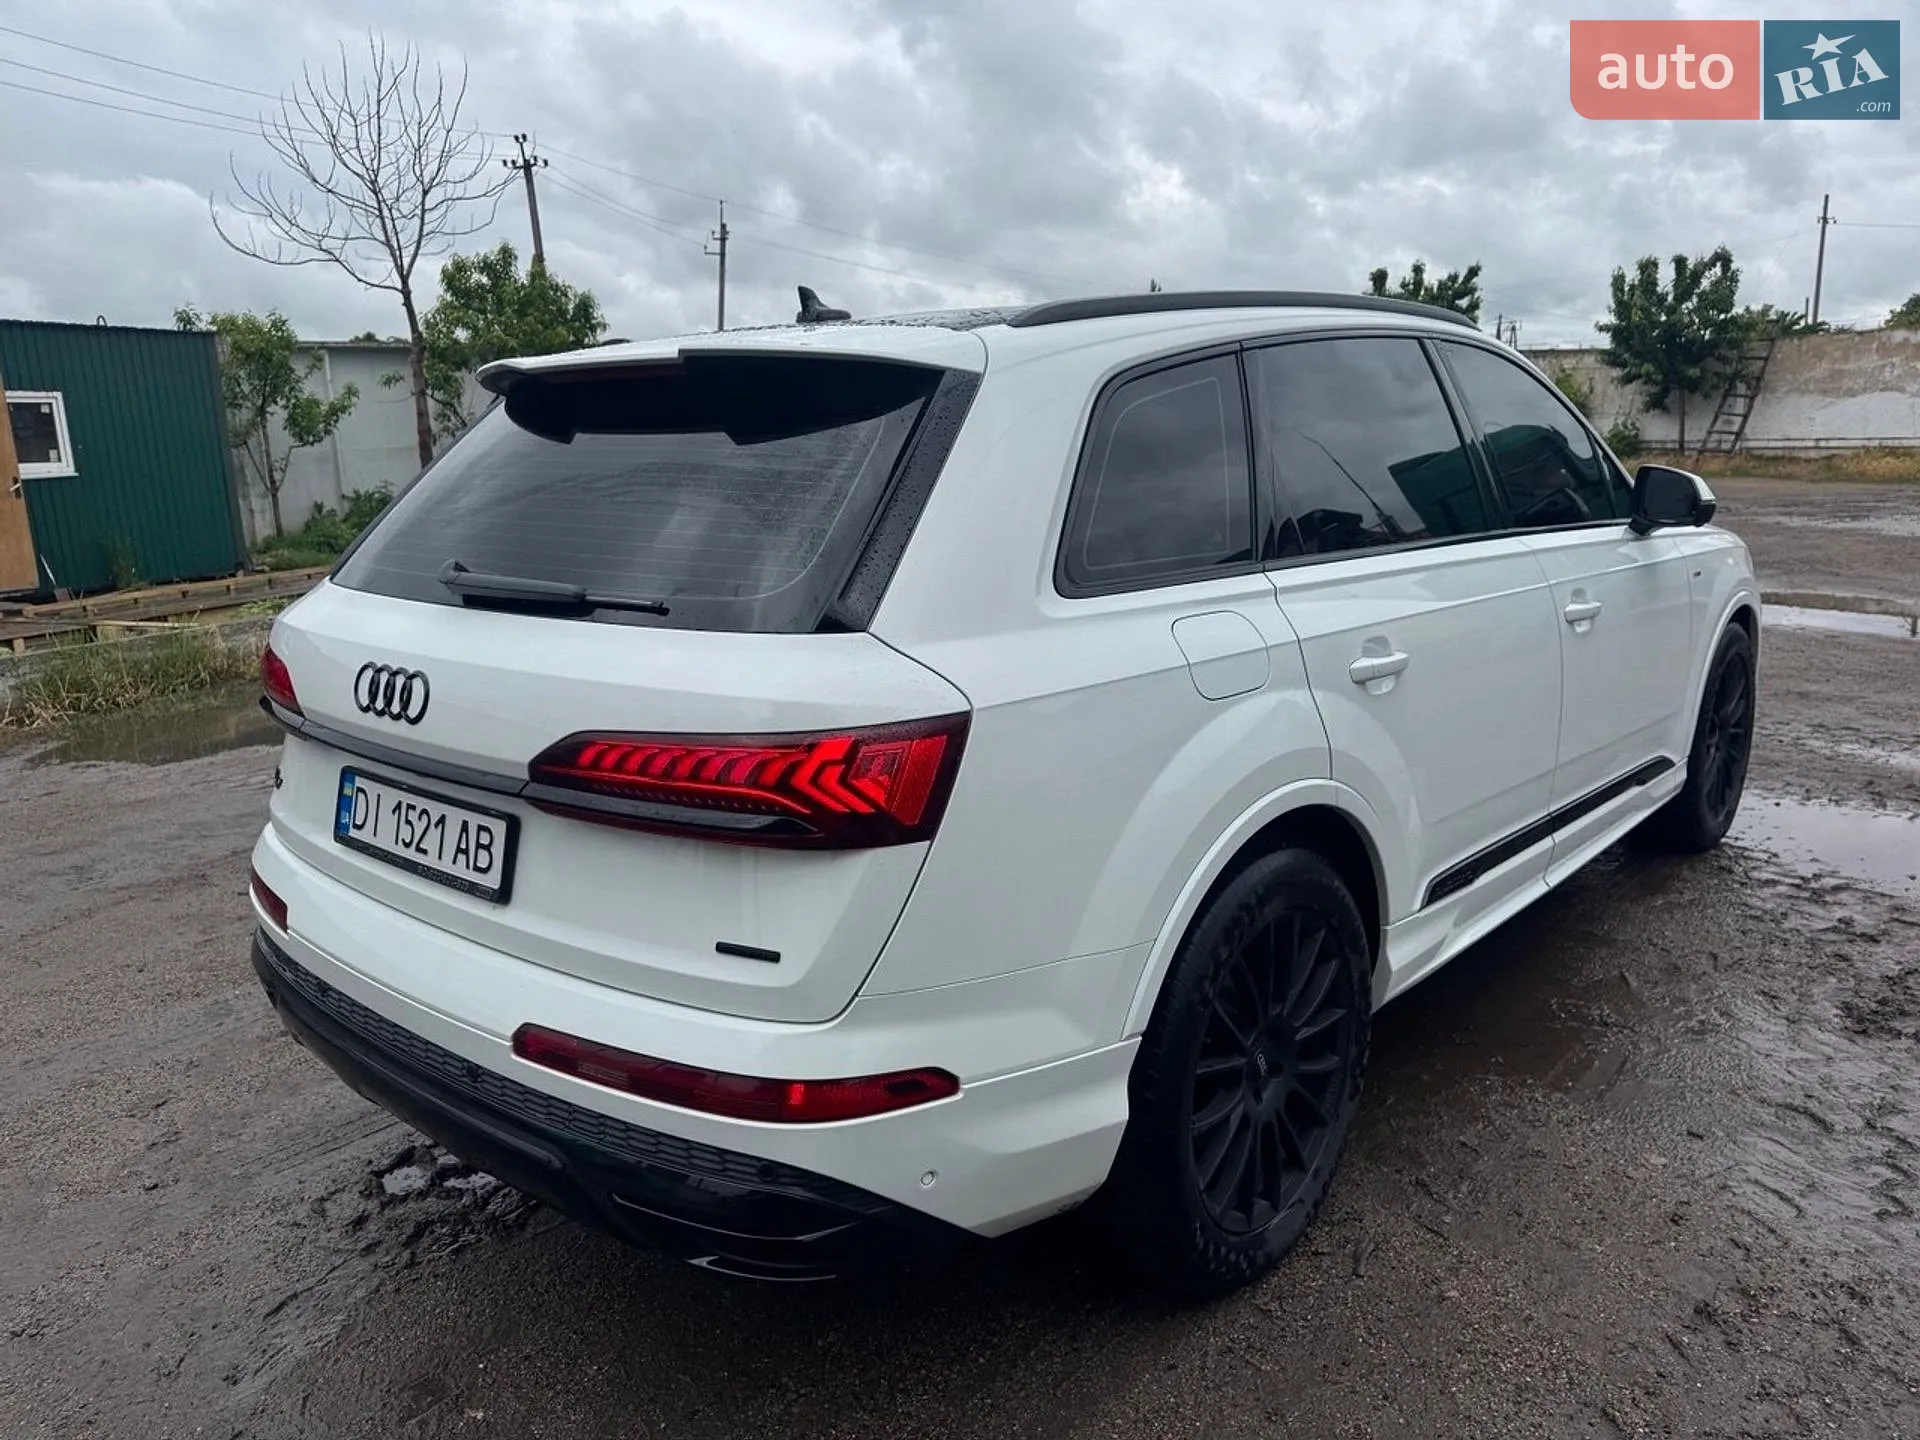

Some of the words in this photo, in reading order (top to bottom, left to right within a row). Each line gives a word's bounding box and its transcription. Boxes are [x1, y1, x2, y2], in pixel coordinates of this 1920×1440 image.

[352, 786, 381, 837] DI
[392, 800, 446, 860] 1521
[452, 819, 494, 874] AB
